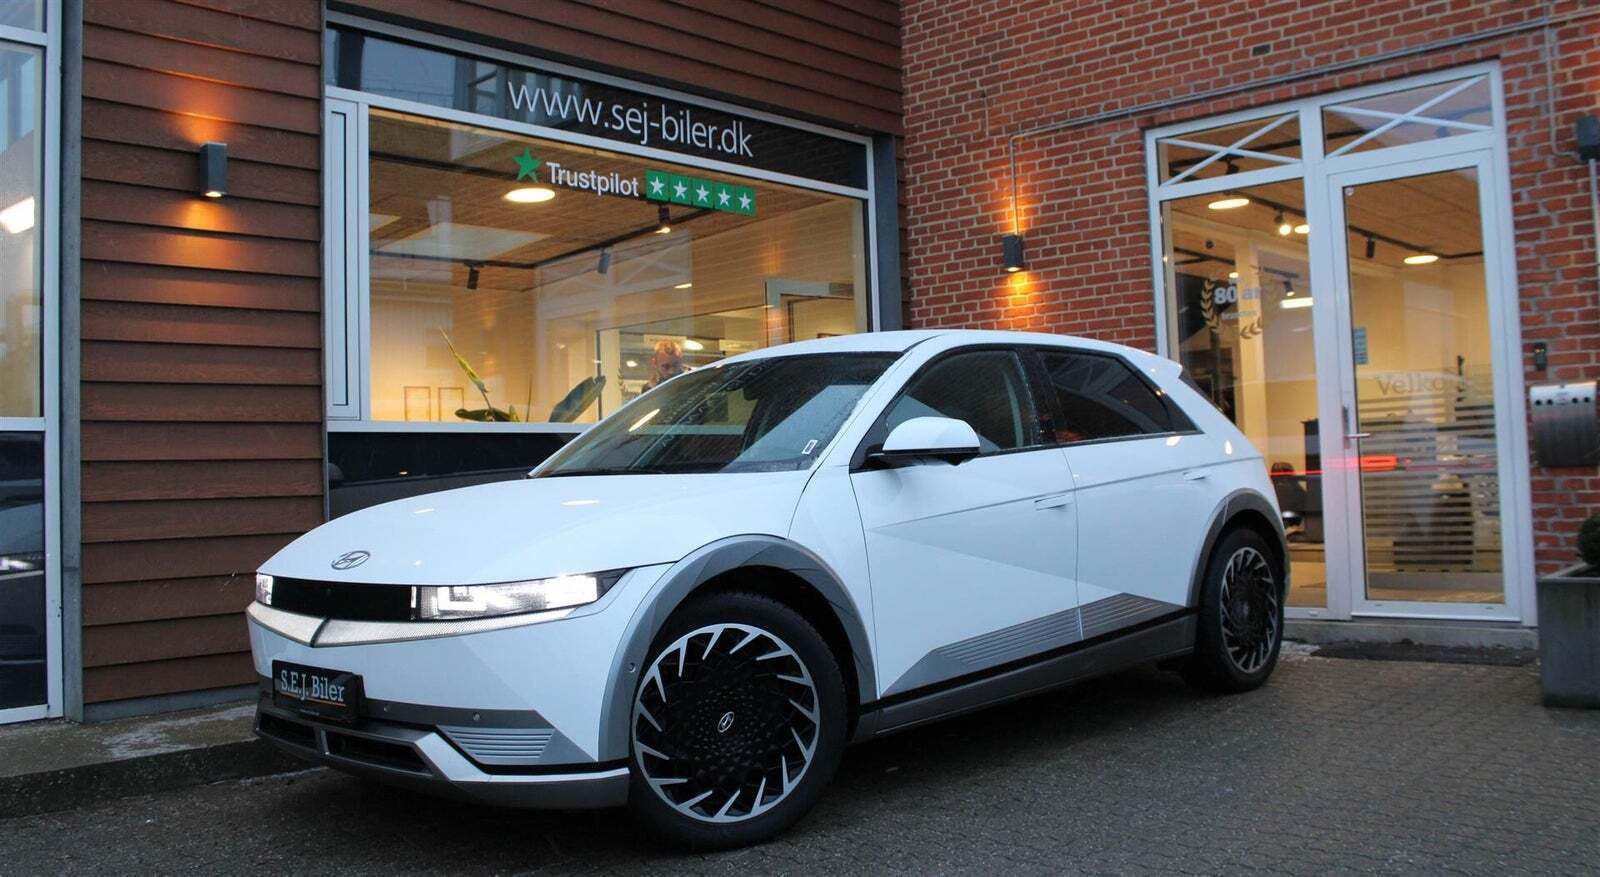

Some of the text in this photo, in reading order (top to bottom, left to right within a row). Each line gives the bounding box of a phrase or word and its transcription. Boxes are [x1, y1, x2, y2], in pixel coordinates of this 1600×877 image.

[508, 81, 753, 157] www.sej-biler.dk
[546, 161, 639, 197] Trustpilot
[1214, 286, 1237, 304] 80
[281, 670, 345, 702] S.E.J. Biler
